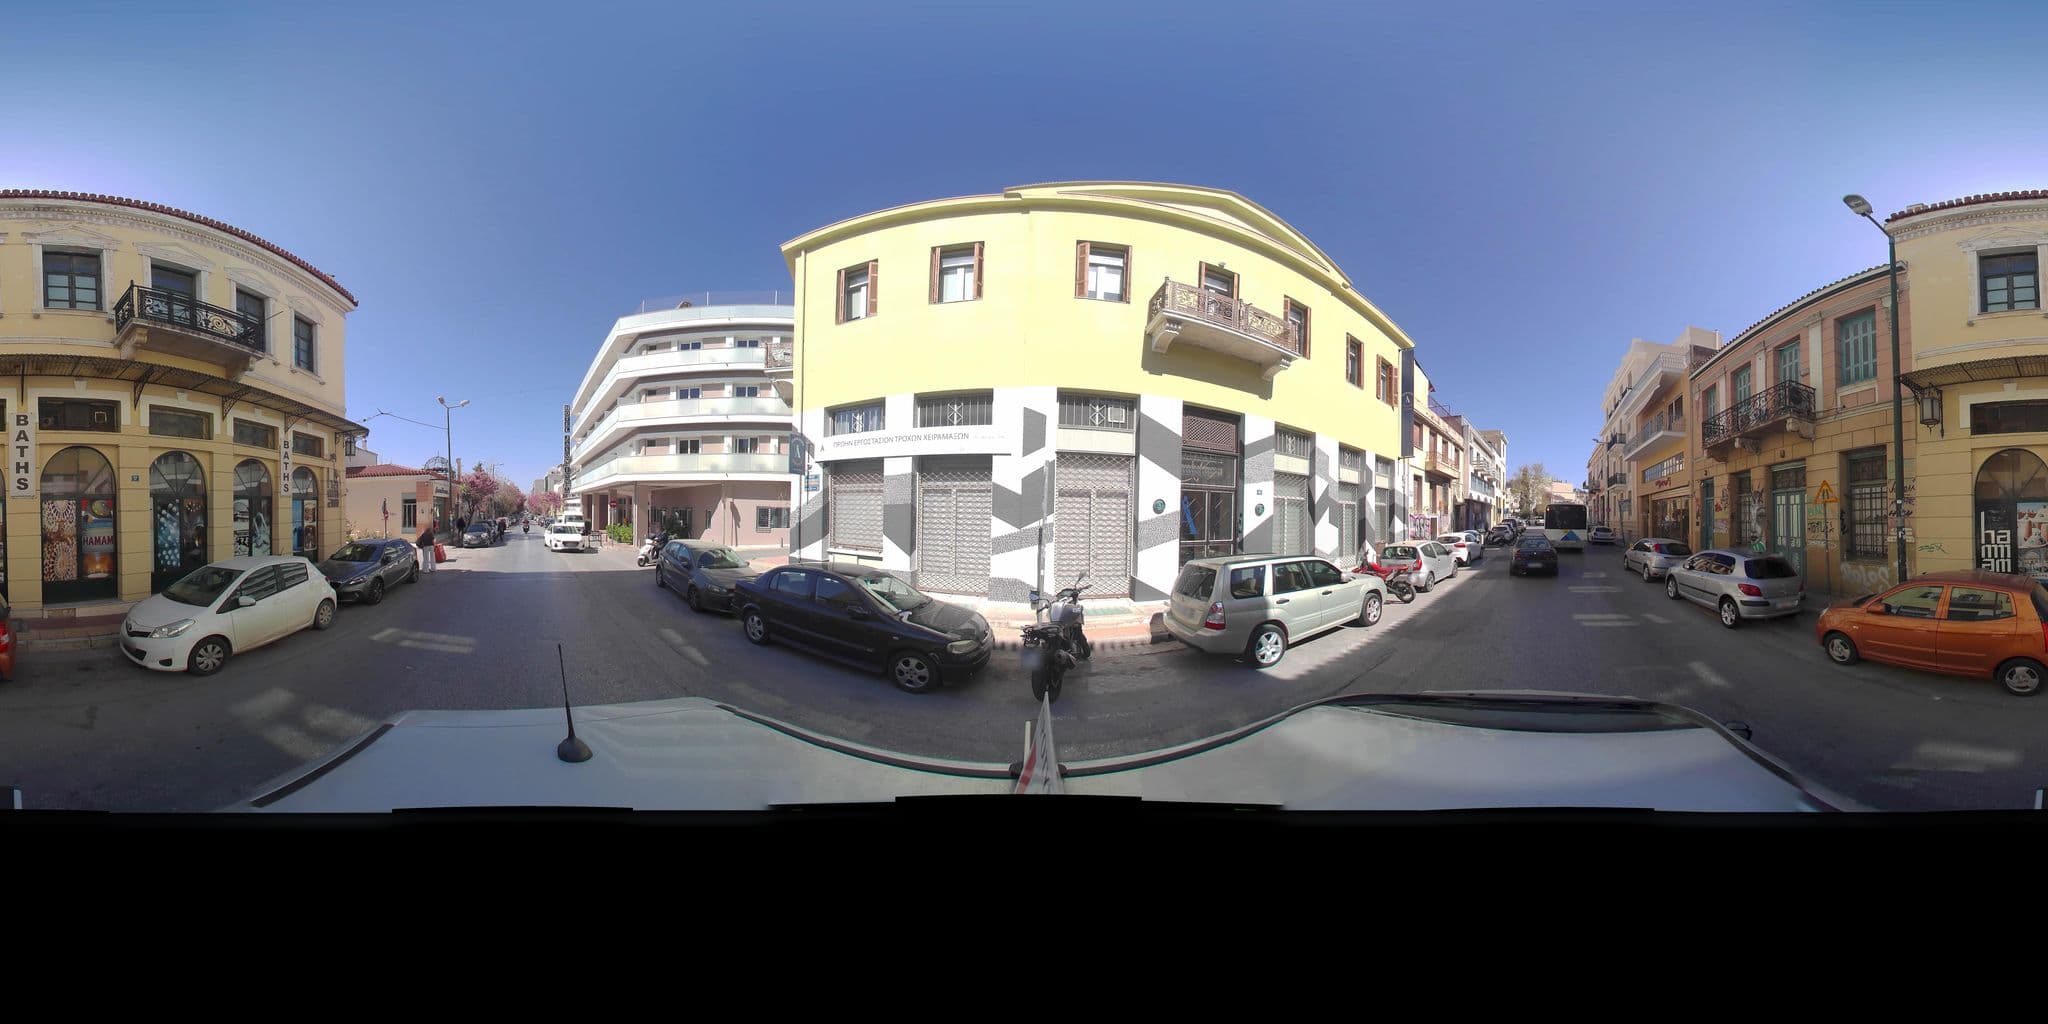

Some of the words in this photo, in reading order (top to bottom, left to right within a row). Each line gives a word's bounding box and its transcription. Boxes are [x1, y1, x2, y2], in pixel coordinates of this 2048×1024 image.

[923, 432, 969, 440] ΧΕΙΡΑΜΑΞΩΝ
[15, 415, 29, 491] BATHS
[83, 535, 113, 546] HAMAM
